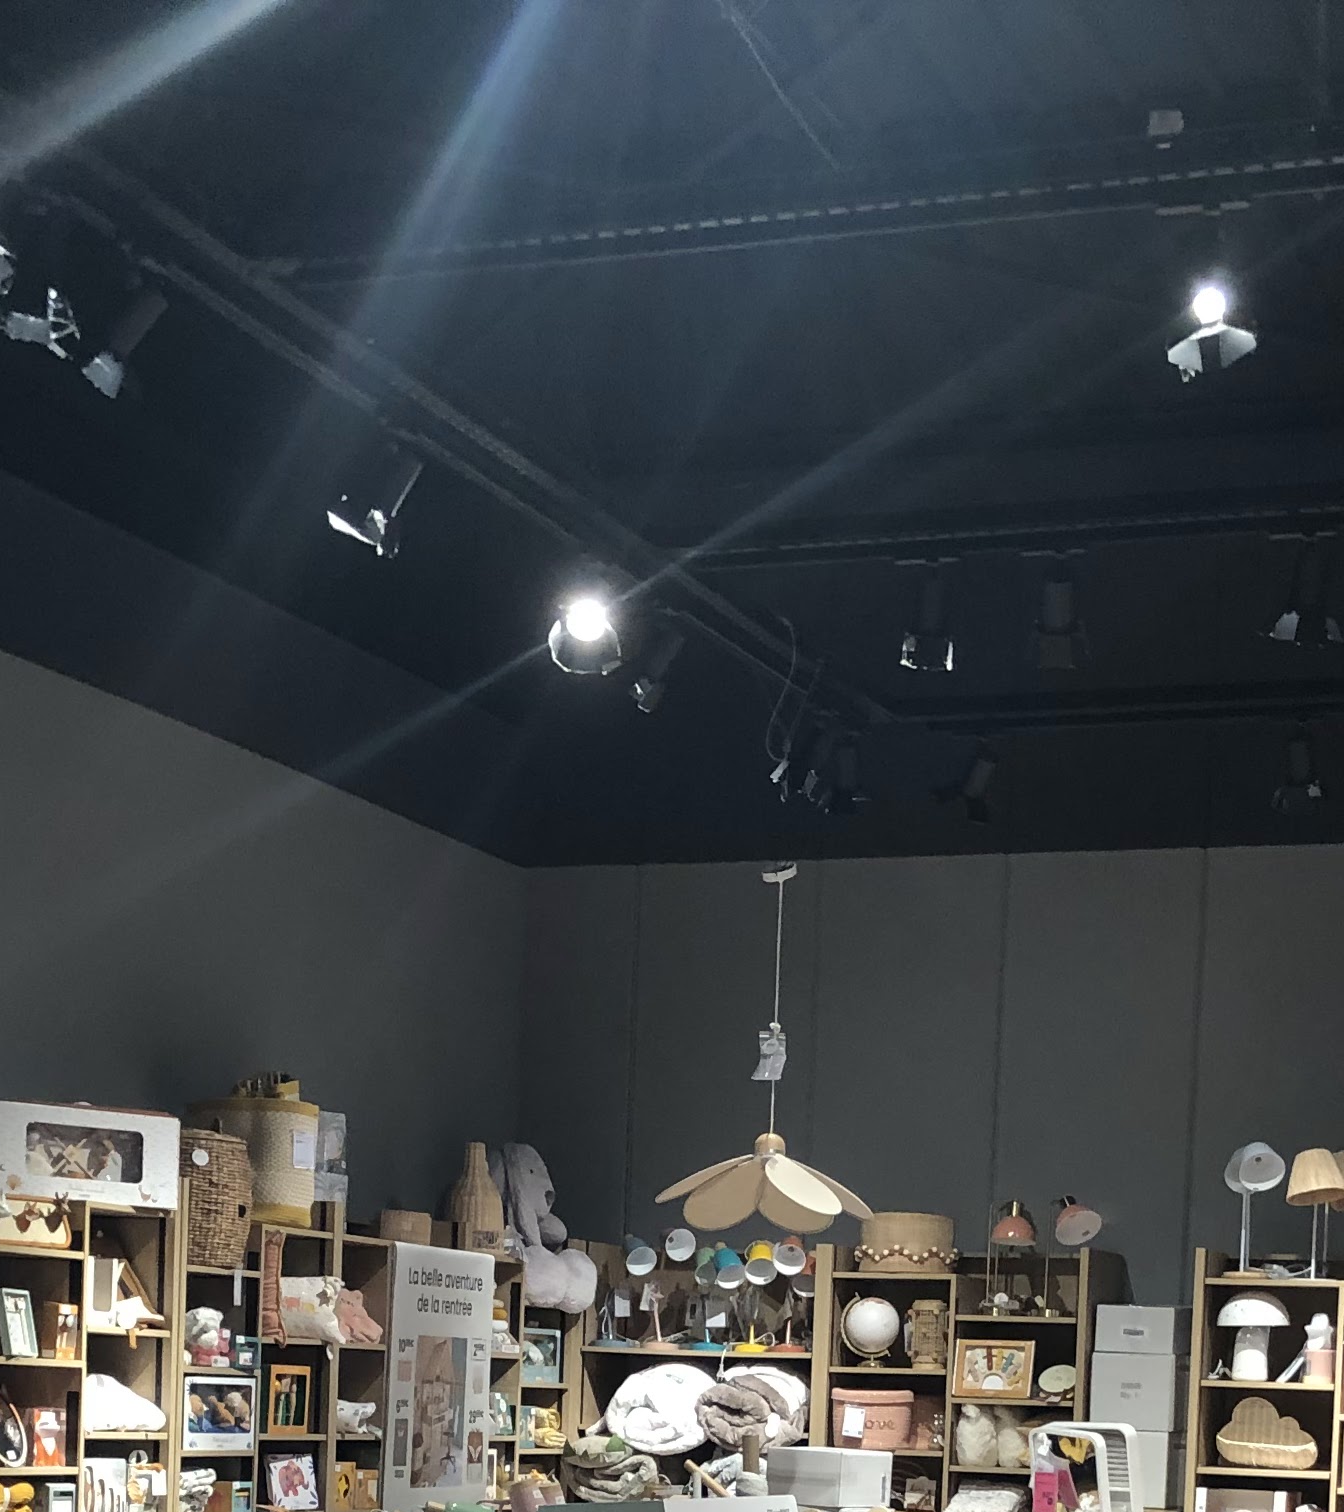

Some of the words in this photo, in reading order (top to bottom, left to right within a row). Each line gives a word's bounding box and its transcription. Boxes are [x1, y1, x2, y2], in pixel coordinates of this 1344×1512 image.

[409, 1267, 419, 1285] La
[421, 1268, 443, 1287] belle
[445, 1273, 483, 1292] aventure
[417, 1294, 428, 1313] de
[431, 1295, 440, 1314] la
[442, 1297, 473, 1316] rentrée
[864, 1419, 896, 1430] ove
